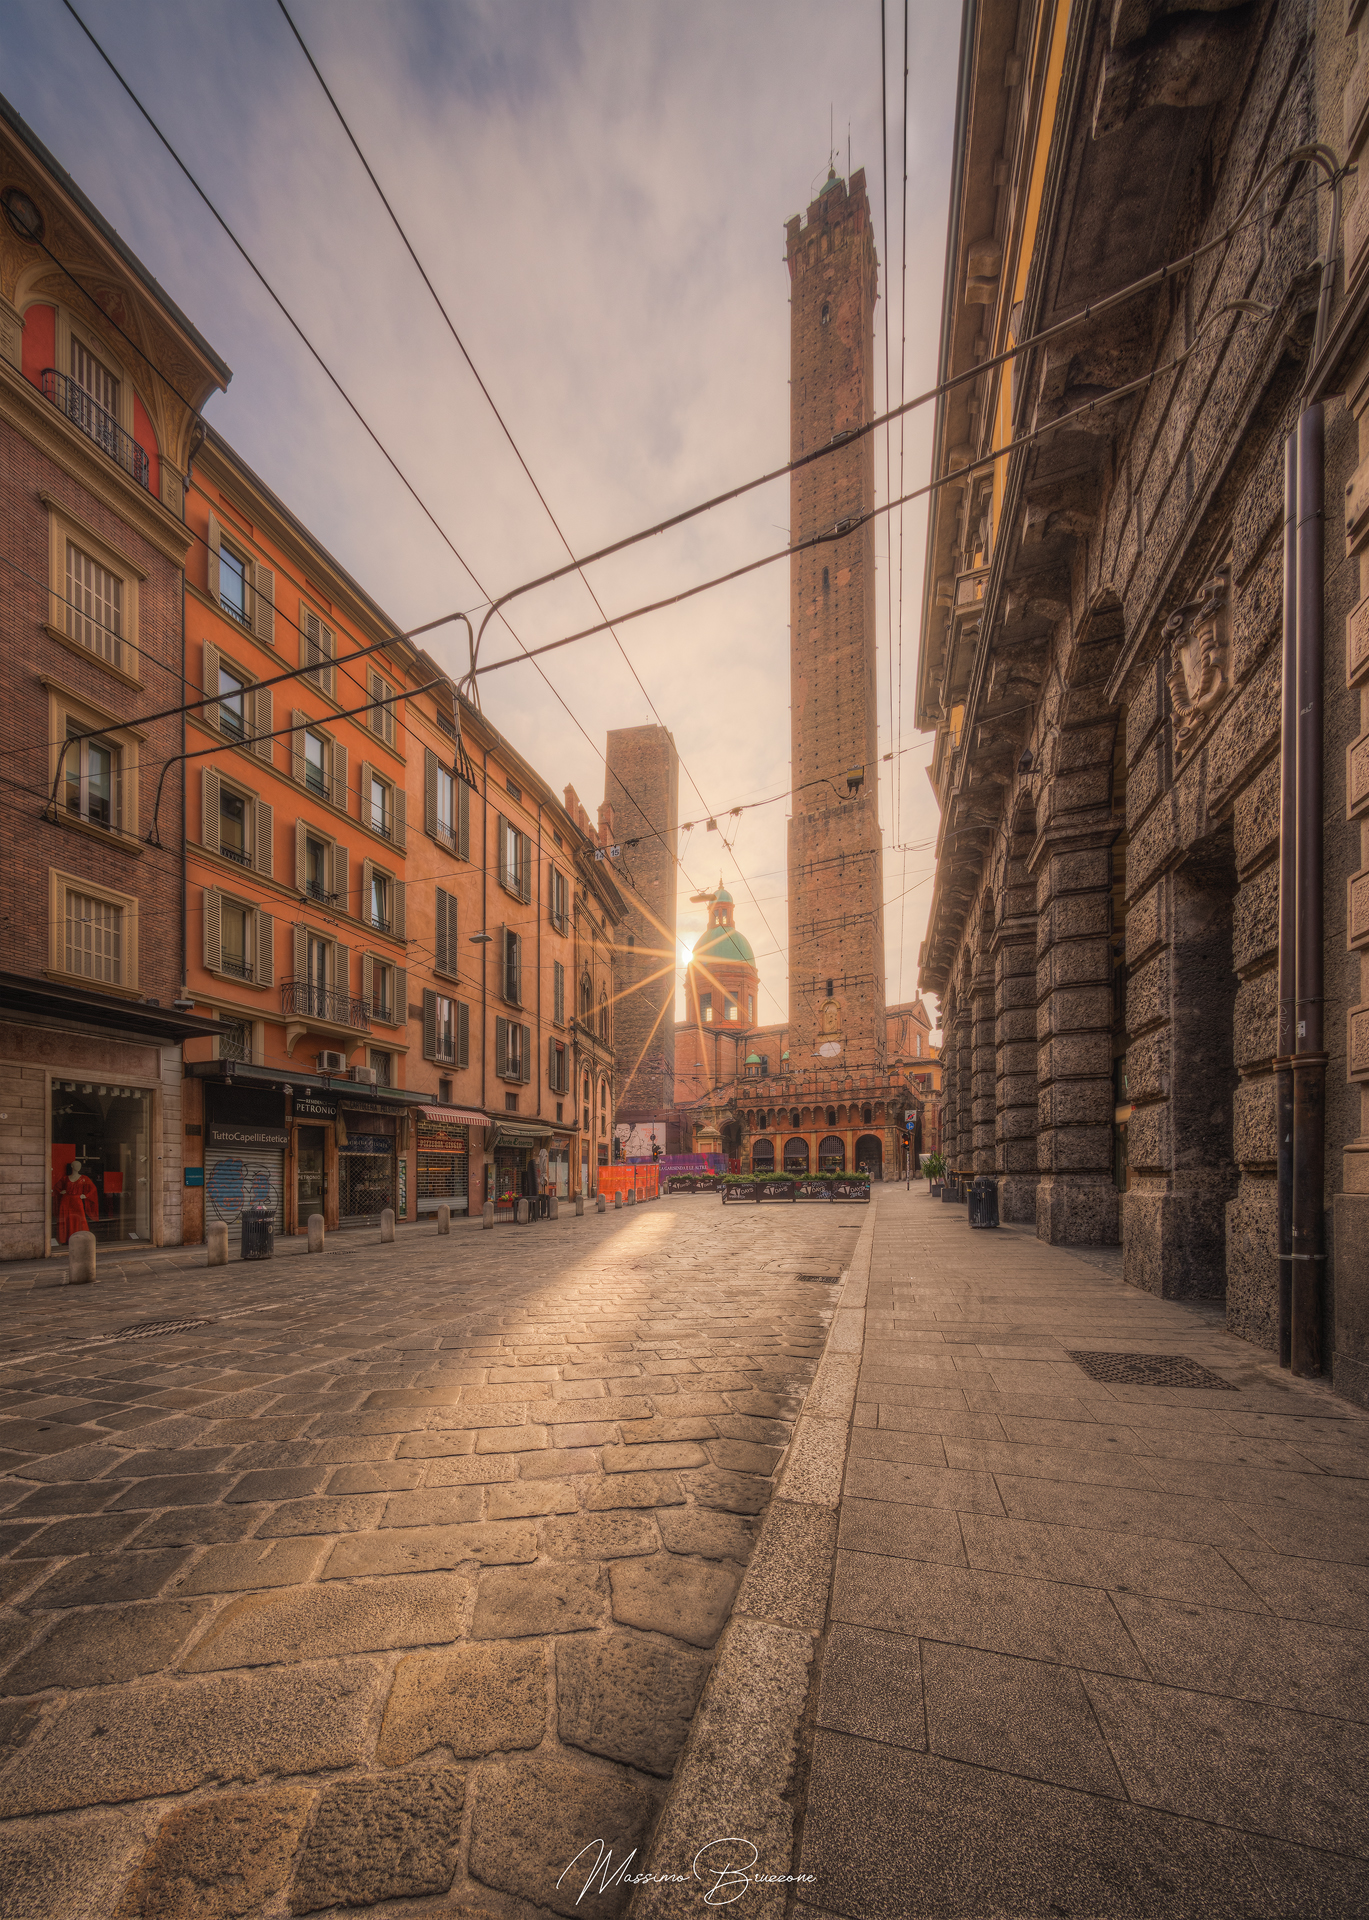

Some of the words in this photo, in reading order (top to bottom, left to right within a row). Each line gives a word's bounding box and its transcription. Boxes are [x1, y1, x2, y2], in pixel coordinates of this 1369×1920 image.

[305, 1098, 328, 1106] RESIDENCE
[350, 1101, 378, 1112] CARTOLERIA
[296, 1103, 337, 1115] PETRONIO
[212, 1130, 288, 1143] TuttoCapelliEstetica
[498, 1136, 512, 1146] Verde
[512, 1137, 533, 1147] Essenza
[774, 1186, 788, 1194] DAYS
